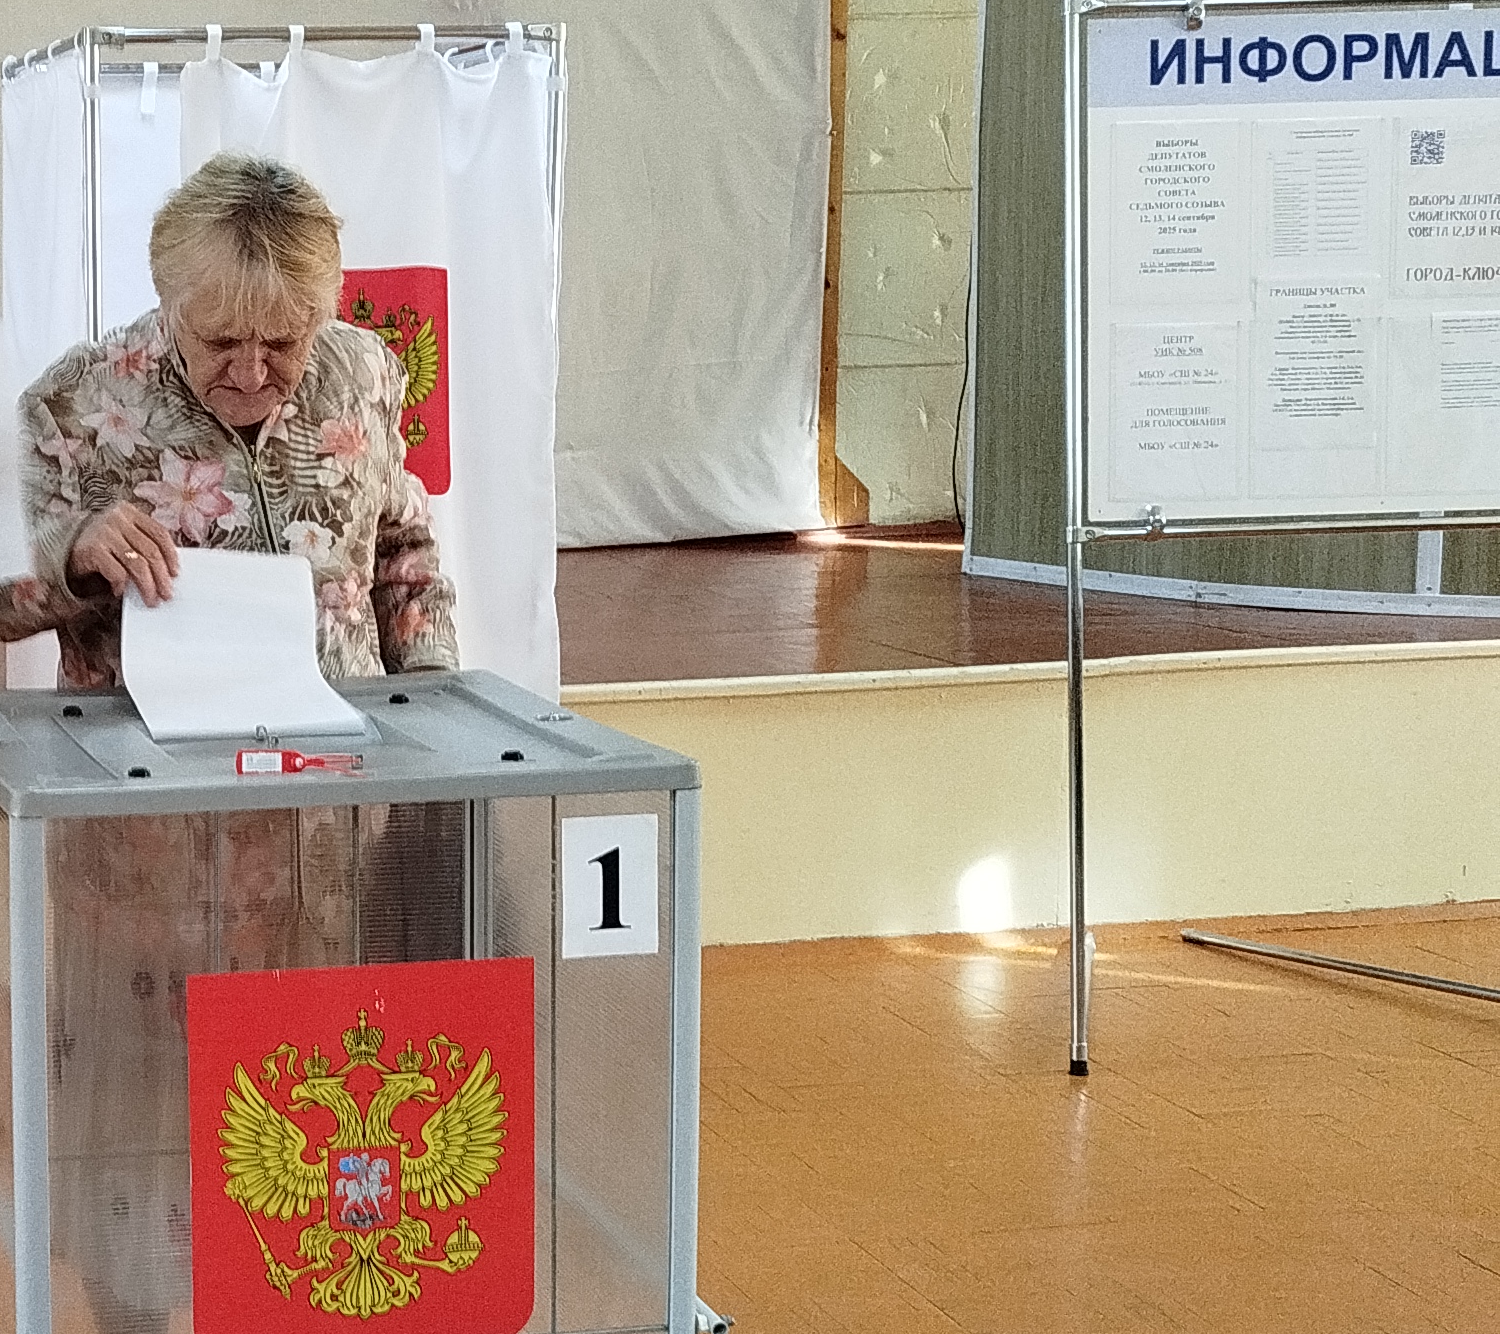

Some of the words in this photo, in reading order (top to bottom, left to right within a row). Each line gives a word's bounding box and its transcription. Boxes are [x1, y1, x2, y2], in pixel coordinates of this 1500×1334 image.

[1155, 139, 1199, 148] ВЫБОРЫ
[1147, 151, 1207, 161] ДЕПУТАТОВ
[1138, 163, 1216, 174] СМОЛЕНСКОГО
[1144, 175, 1211, 185] ГОРОДСКОГО
[1157, 188, 1197, 197] СОВЕТА
[1129, 201, 1183, 211] СЕДЬМОГО
[1184, 200, 1226, 209] СОЗЫВА
[1409, 195, 1455, 206] ВЫБОРЫ
[1178, 213, 1216, 223] сентября
[1408, 210, 1487, 222] СМОЛЕНСКОГО
[1158, 226, 1177, 235] 2025
[1408, 226, 1449, 237] СОВЕТА
[1269, 287, 1317, 297] ГРАНИЦЫ
[1319, 286, 1366, 296] УЧАСТКА
[1162, 335, 1194, 345] ЦЕНТР
[1138, 370, 1166, 379] МБОУ
[1146, 407, 1211, 417] ПОМЕЩЕНИЕ
[1130, 419, 1150, 429] ДЛЯ
[1152, 418, 1227, 428] ГОЛОСОВАНИЯ
[1138, 441, 1166, 450] МБОУ
[587, 845, 633, 932] 1
